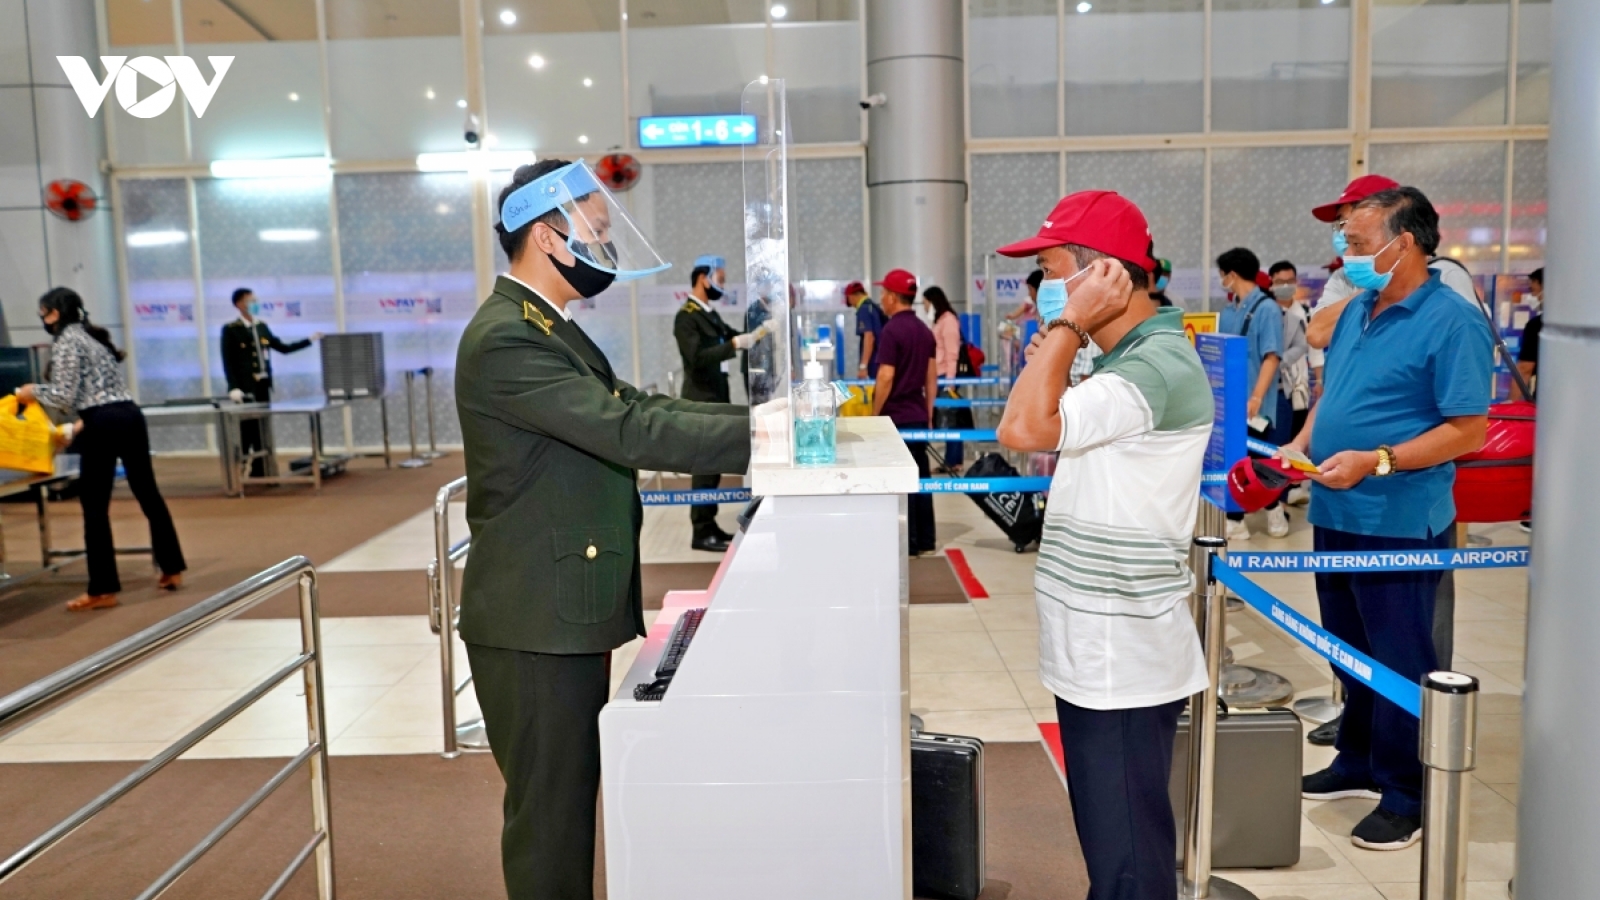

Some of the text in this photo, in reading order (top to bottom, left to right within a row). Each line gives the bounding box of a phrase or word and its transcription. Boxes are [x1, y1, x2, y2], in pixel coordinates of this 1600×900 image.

[953, 482, 968, 491] CAM
[970, 482, 989, 491] RANH
[674, 491, 753, 503] INTERNATION
[1228, 550, 1529, 568] M RANH INTERNATIONAL AIRPORT
[1339, 650, 1354, 670] CAM
[1353, 658, 1372, 682] RANH
